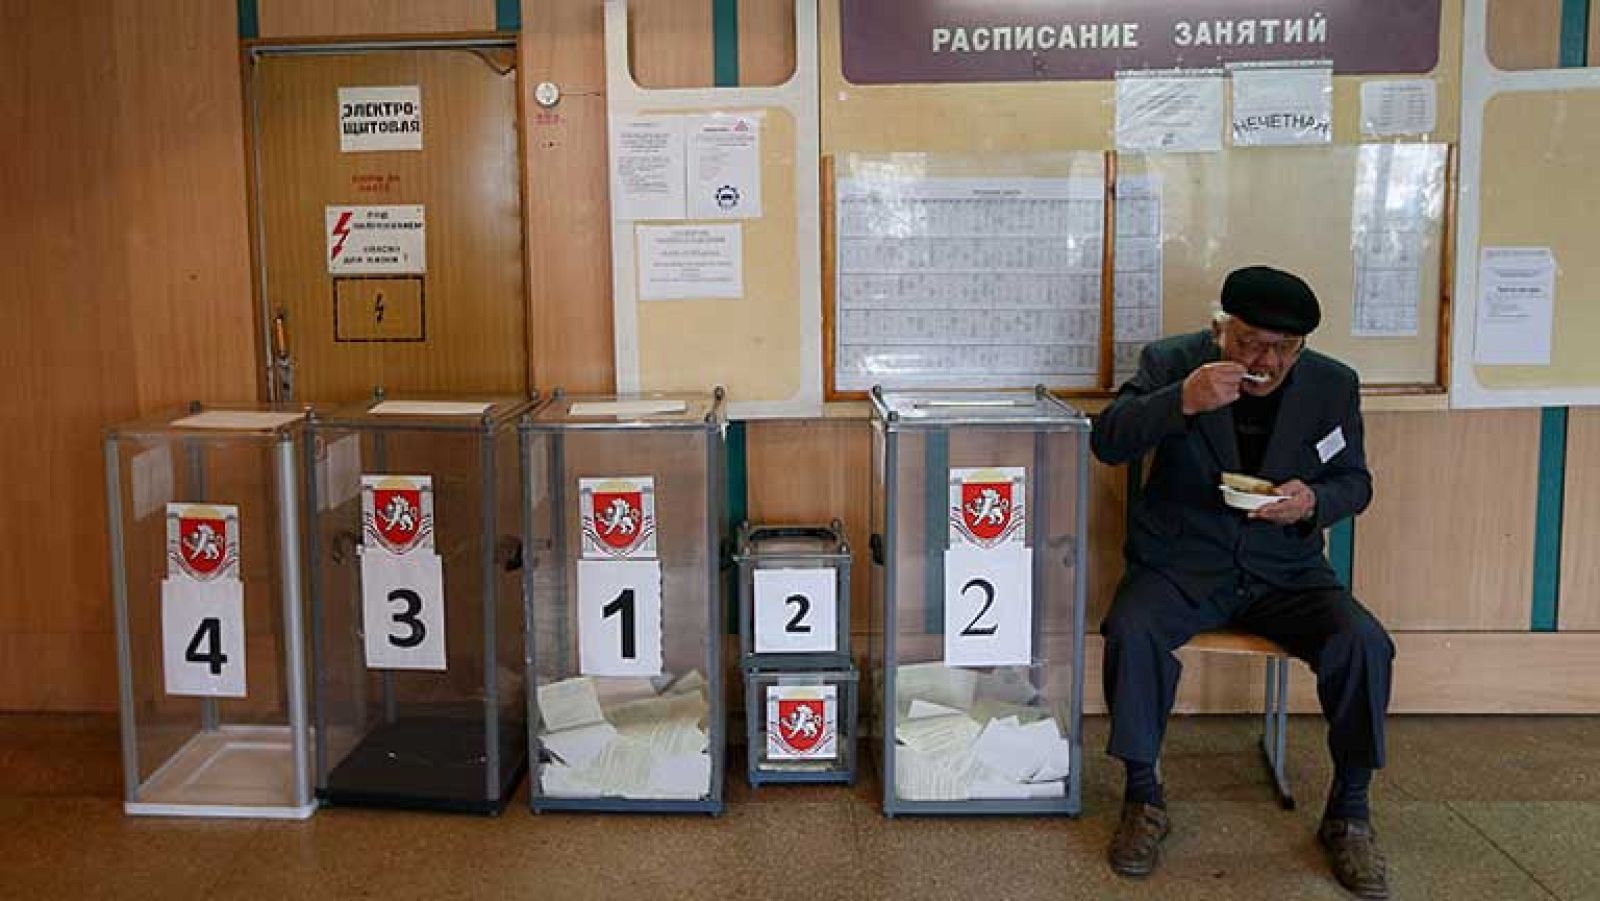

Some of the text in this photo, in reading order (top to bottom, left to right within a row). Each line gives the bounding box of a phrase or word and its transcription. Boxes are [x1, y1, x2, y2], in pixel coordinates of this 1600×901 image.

[932, 12, 1328, 53] РАСПИСАНИЕ ЗАНЯТИЙ
[342, 102, 419, 118] ЭЛЕКТРО-
[343, 120, 420, 135] ЩИТОВАЯ
[386, 588, 427, 649] 3
[601, 588, 636, 660] 1
[785, 593, 811, 633] 2
[960, 578, 999, 637] 2
[184, 617, 228, 675] 4
